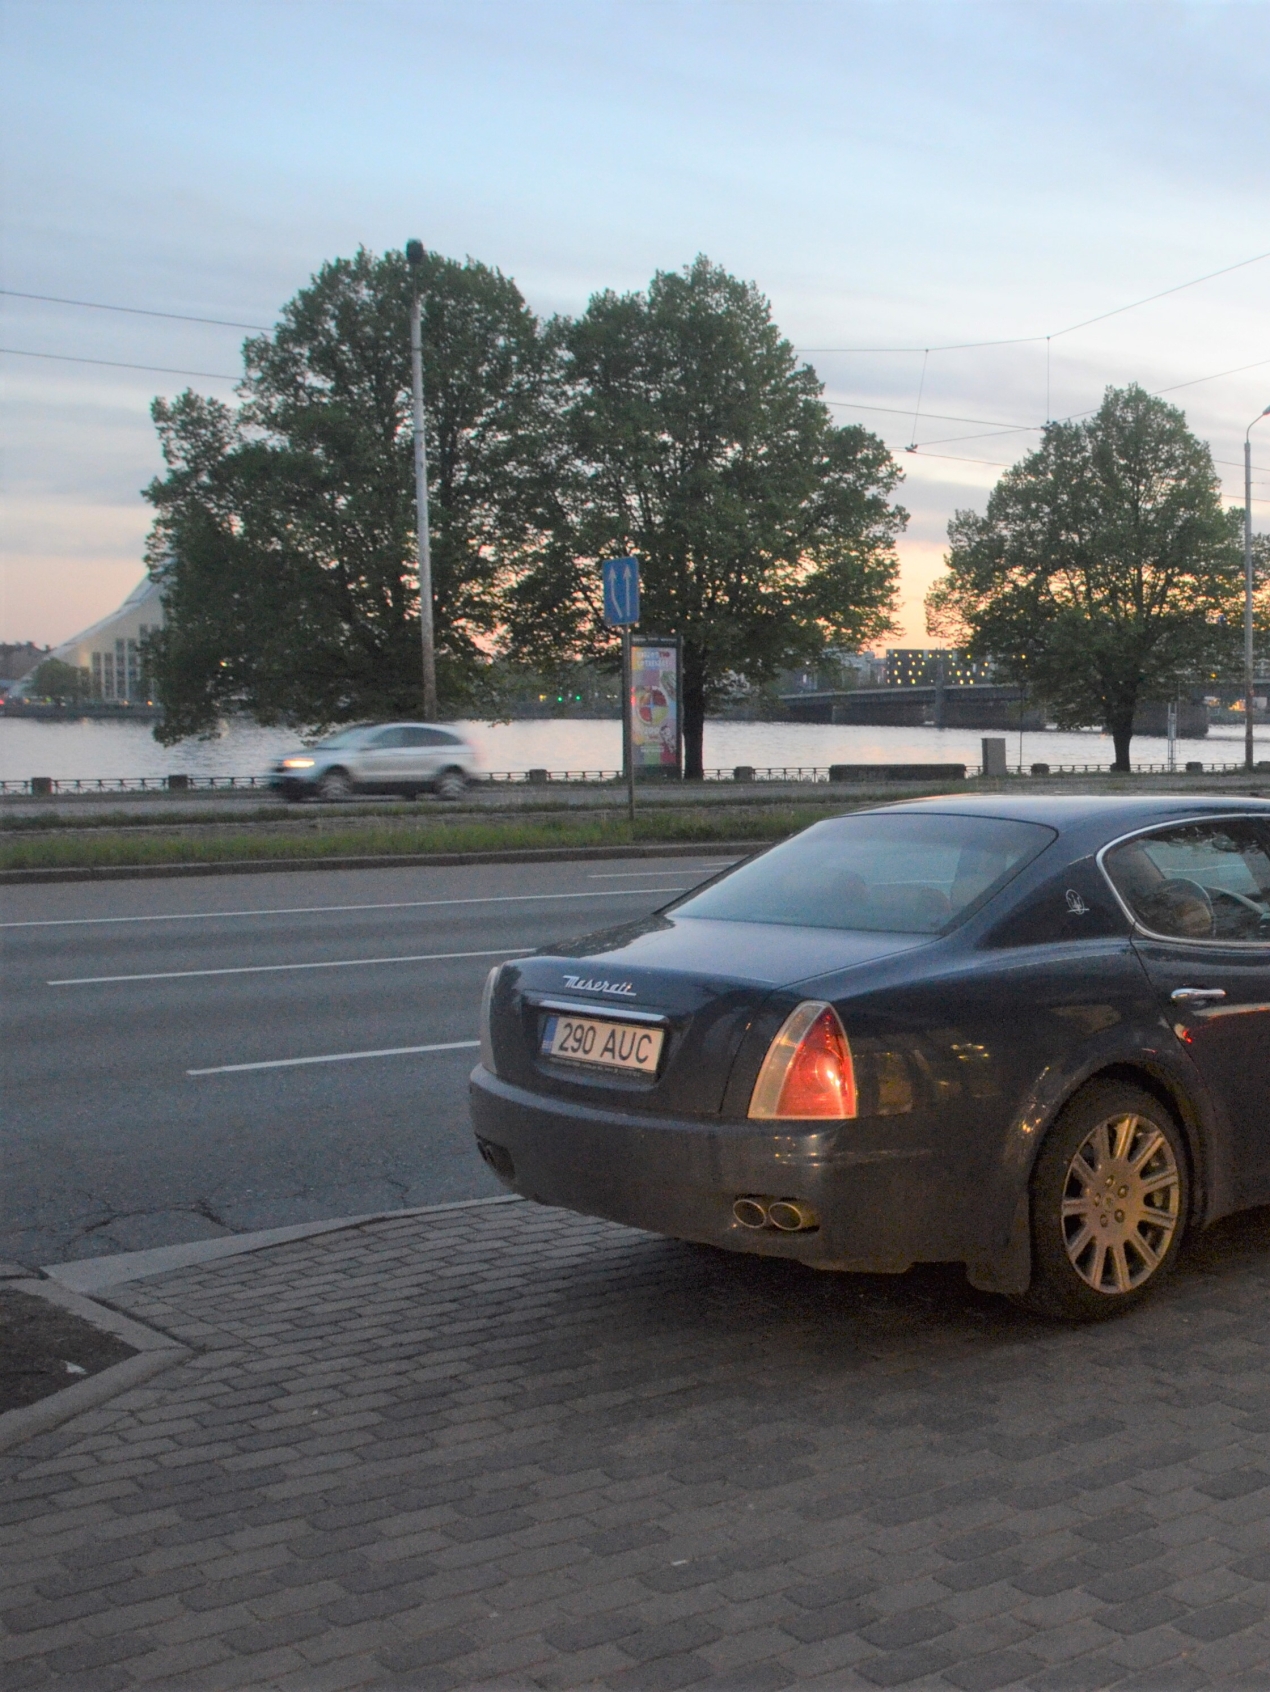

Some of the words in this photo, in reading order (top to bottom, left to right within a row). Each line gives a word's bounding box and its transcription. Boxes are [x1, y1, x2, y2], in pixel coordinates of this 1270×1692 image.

[562, 974, 637, 996] Maserati
[558, 1022, 597, 1055] 290
[600, 1028, 653, 1064] AUC
